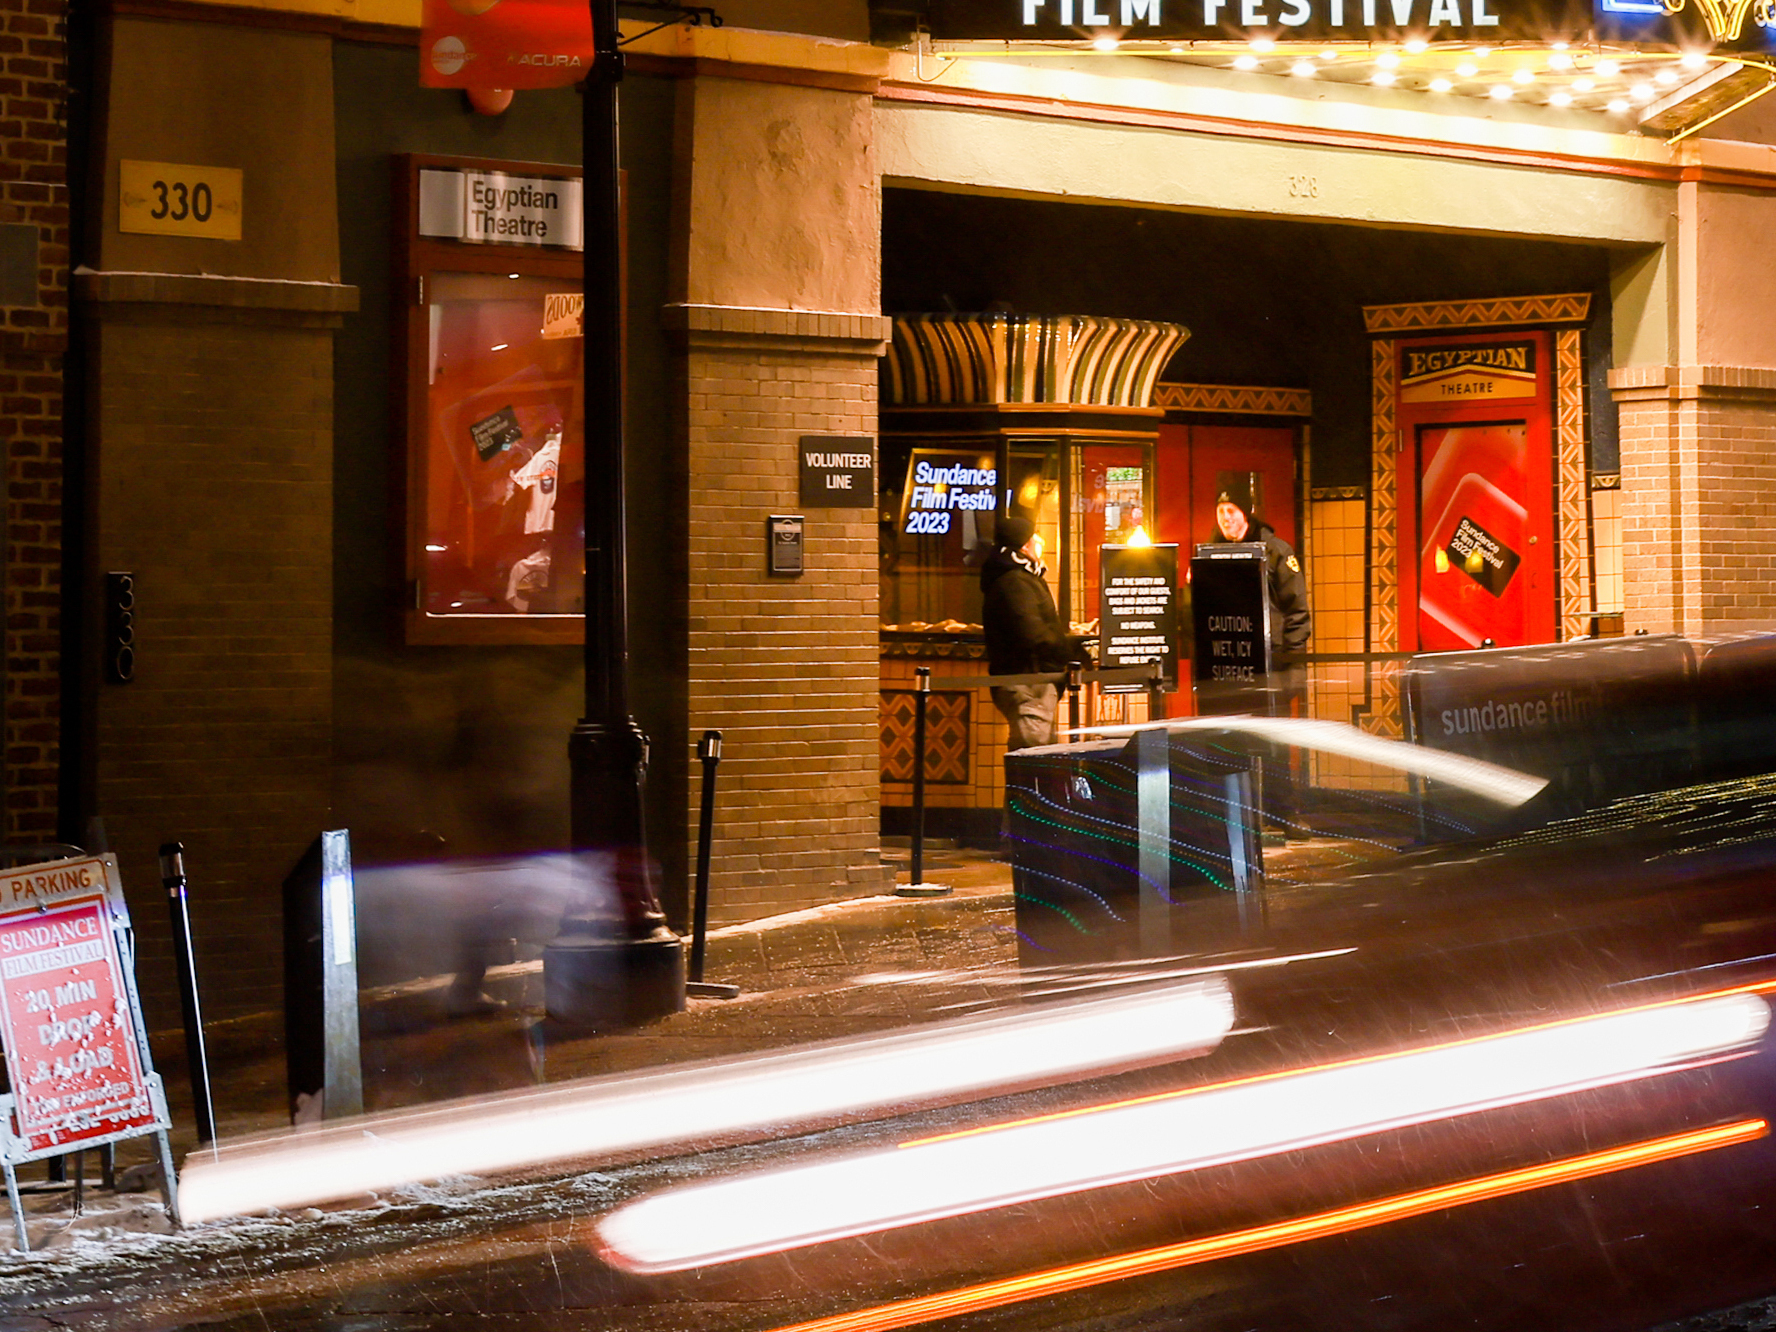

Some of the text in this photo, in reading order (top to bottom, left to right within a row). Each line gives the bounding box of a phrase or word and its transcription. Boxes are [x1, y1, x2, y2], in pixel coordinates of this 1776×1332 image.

[518, 54, 581, 67] ACURA
[150, 180, 214, 223] 330
[471, 180, 558, 213] Egyptian
[471, 209, 548, 238] Theatre
[1409, 347, 1528, 375] EGYPTIAN
[1441, 382, 1494, 395] THEATRE
[805, 452, 872, 470] VOLUNTEER
[914, 461, 997, 486] Sundance
[825, 473, 852, 490] LINE
[911, 486, 1012, 511] Film Festivl
[905, 511, 950, 534] 2023
[1460, 519, 1500, 554] Sundance
[1455, 528, 1504, 569] Film Festival
[1208, 616, 1253, 632] CAUTION:
[1212, 641, 1252, 658] WET, ICY
[1212, 665, 1255, 683] SURFACE
[1442, 701, 1548, 735] sundance
[11, 868, 91, 901] PARKING
[0, 916, 99, 953] SUNDANCE
[5, 941, 102, 977] FILM FESTIVAL
[25, 979, 98, 1013] 20 MIN
